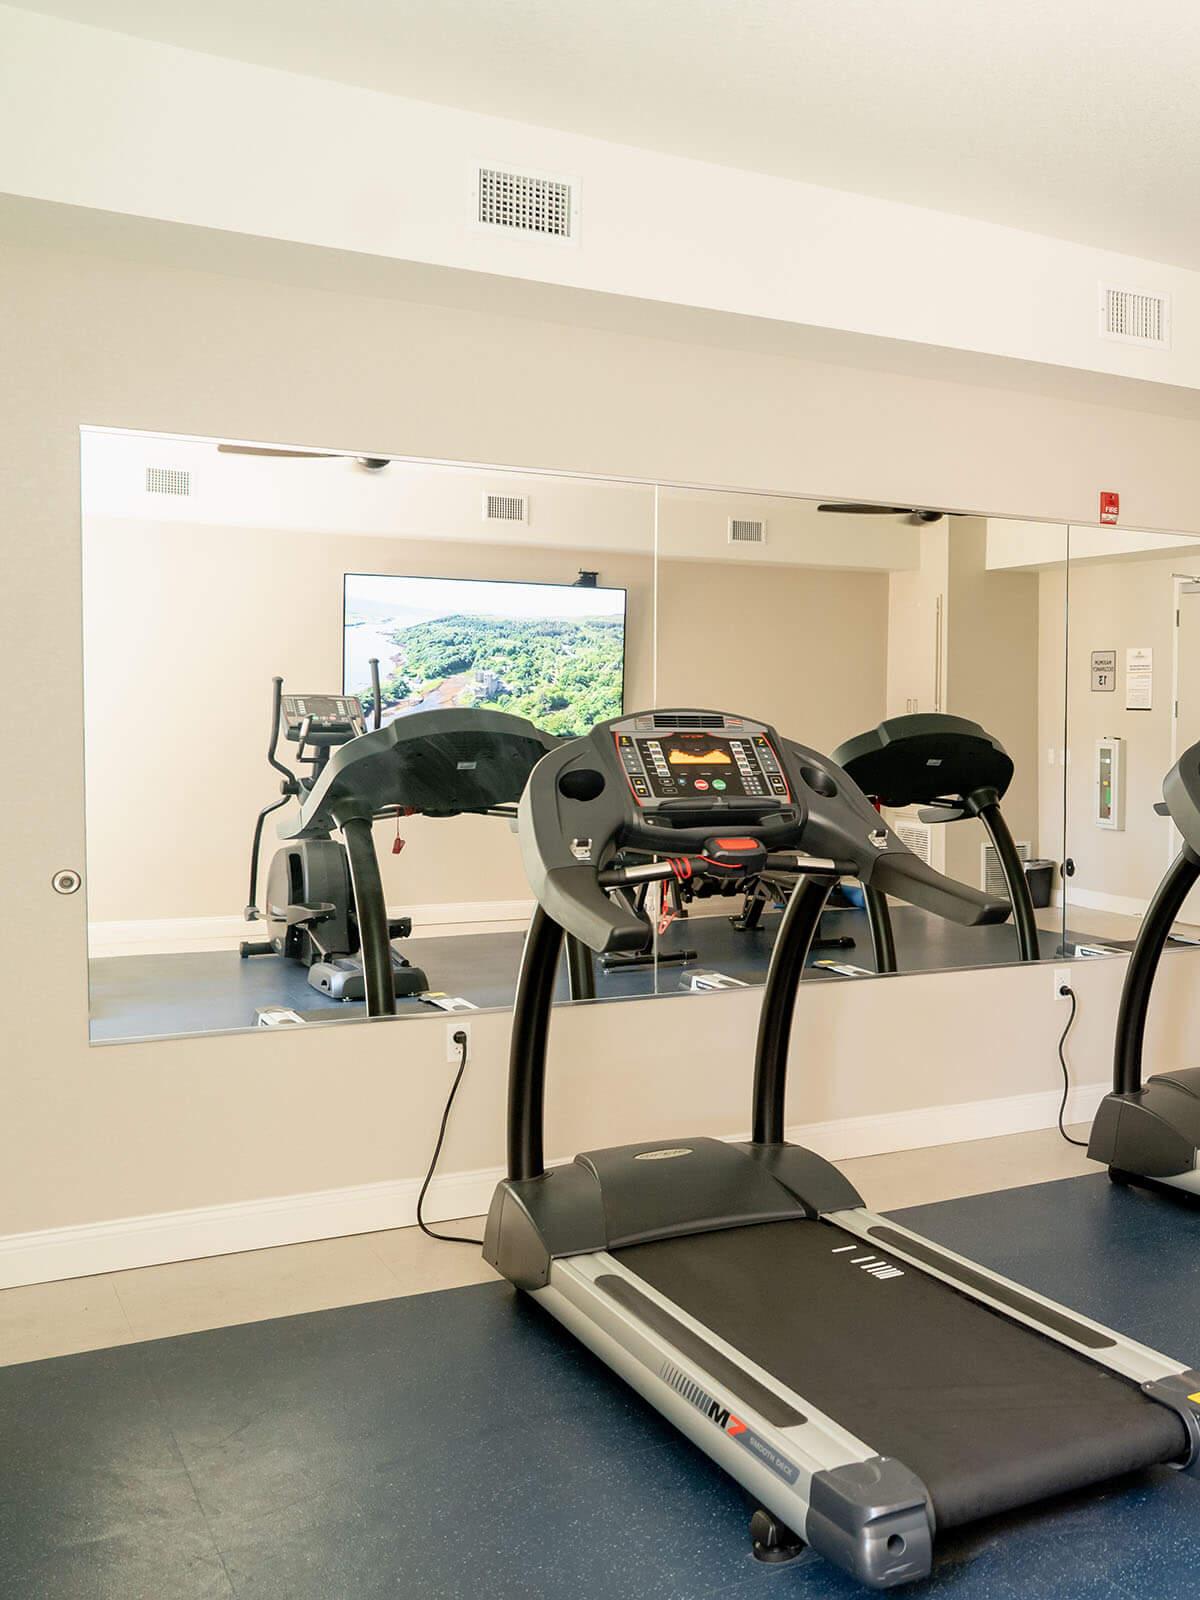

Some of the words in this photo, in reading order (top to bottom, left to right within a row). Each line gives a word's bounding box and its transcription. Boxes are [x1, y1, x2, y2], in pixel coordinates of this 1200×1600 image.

[1105, 506, 1118, 514] FIRE
[707, 1401, 747, 1437] M7
[750, 1436, 776, 1461] SMOOTH
[774, 1455, 793, 1476] DECK
